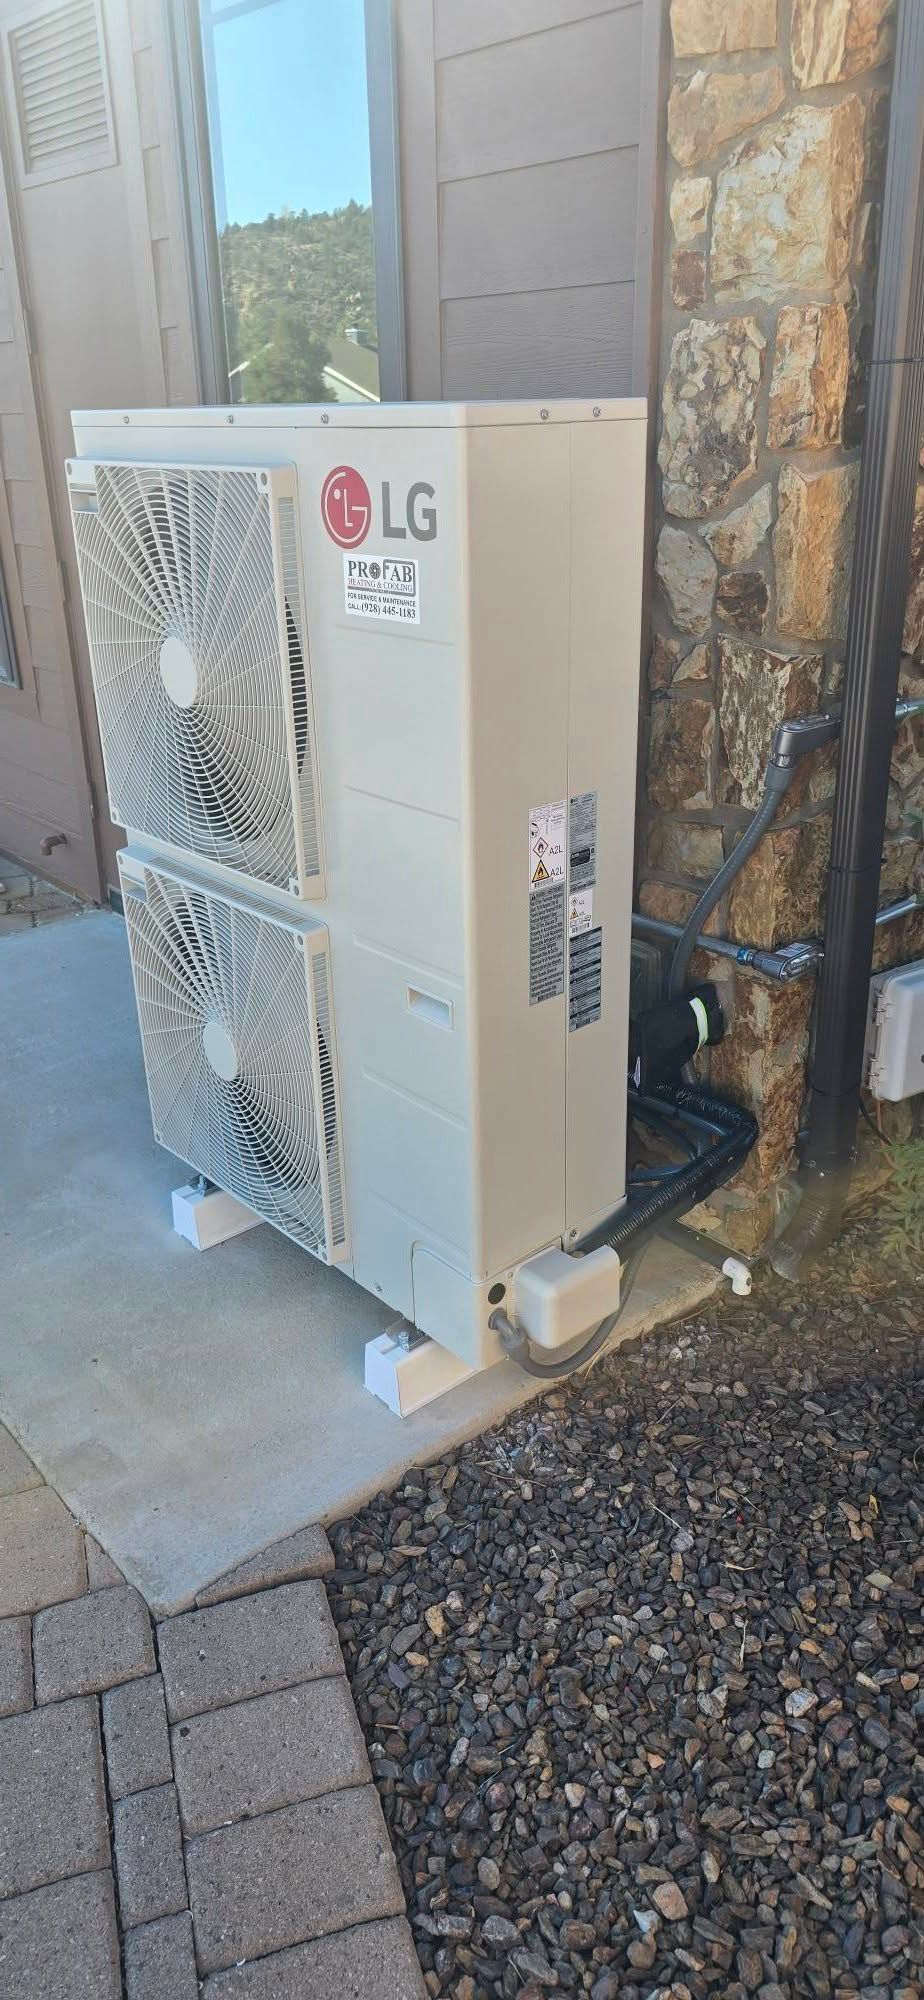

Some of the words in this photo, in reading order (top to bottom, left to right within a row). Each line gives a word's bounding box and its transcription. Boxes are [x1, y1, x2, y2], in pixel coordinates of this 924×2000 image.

[382, 481, 437, 542] LG
[348, 578, 376, 588] HEATING
[383, 582, 413, 592] COOLING
[358, 593, 377, 602] SERVICE
[382, 597, 416, 607] MAINTENANCE
[361, 602, 381, 616] (928)
[382, 605, 416, 619] 445-1183
[549, 844, 563, 856] A2L
[550, 866, 564, 877] A2L
